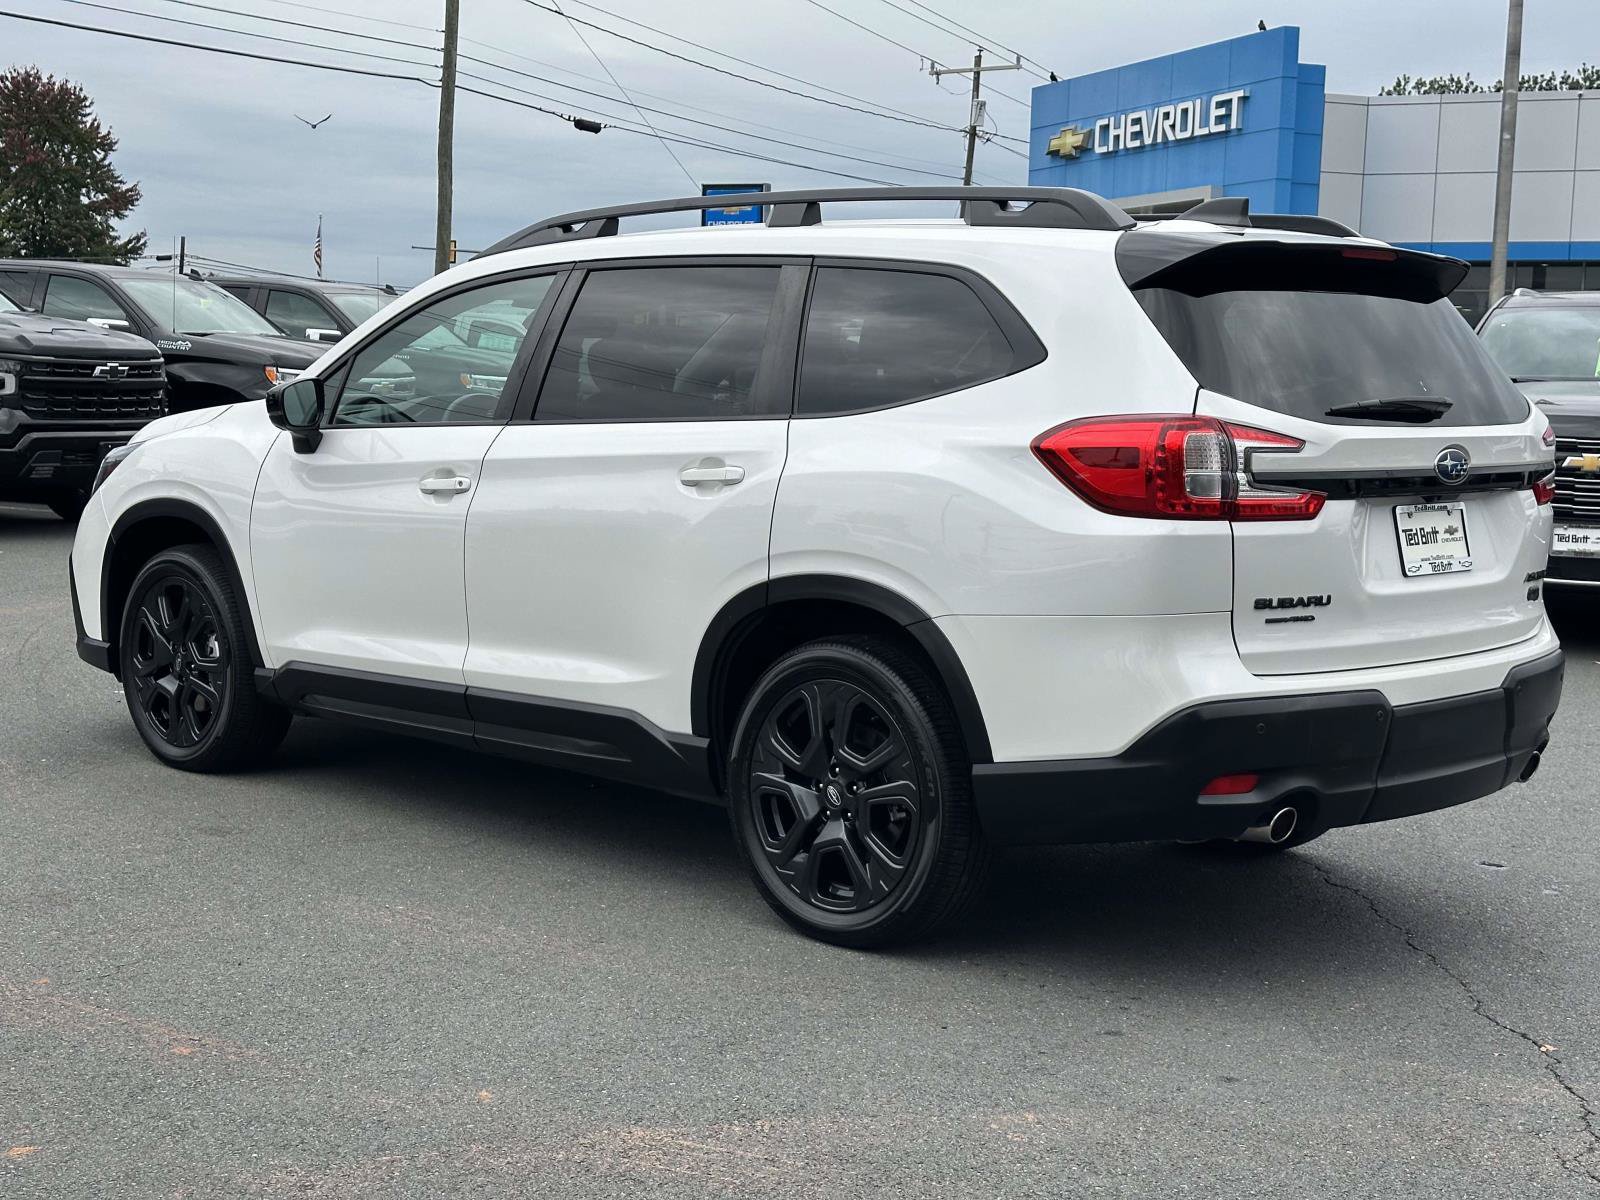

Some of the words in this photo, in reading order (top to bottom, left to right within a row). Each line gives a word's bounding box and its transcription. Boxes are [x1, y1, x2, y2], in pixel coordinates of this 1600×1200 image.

[1094, 89, 1245, 154] CHEVROLET
[1402, 527, 1420, 547] Ted
[1419, 526, 1440, 545] Britt
[1441, 536, 1464, 544] CHEVROLET
[1553, 533, 1570, 543] Ted
[1571, 534, 1591, 544] Britt
[1428, 562, 1441, 573] Ted
[1441, 561, 1453, 572] Britt
[1253, 594, 1332, 610] SUBARU
